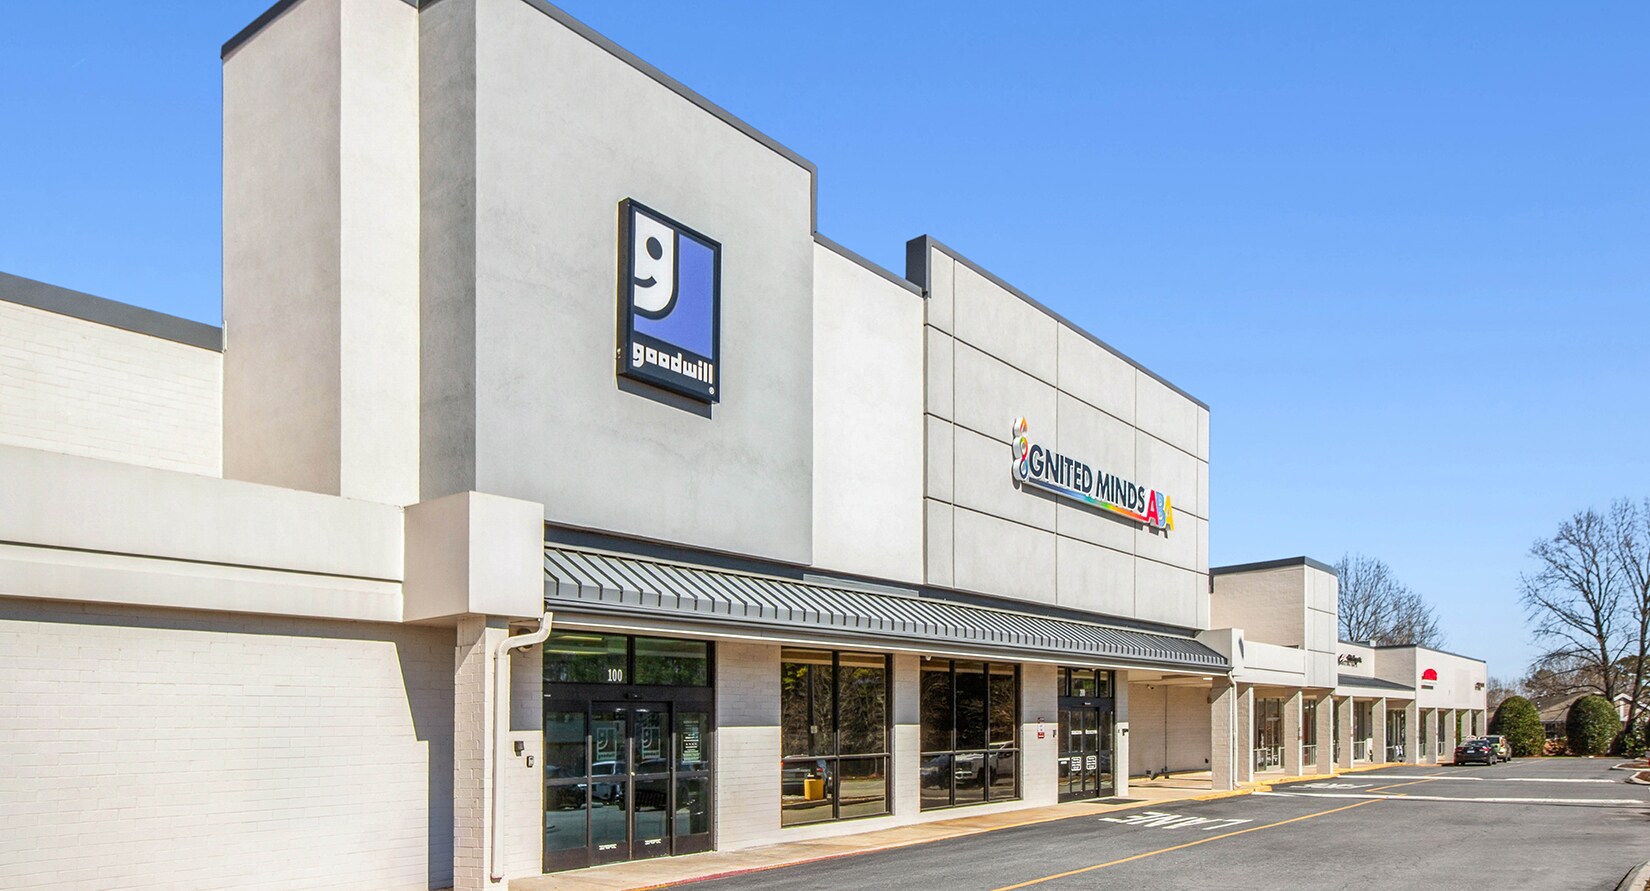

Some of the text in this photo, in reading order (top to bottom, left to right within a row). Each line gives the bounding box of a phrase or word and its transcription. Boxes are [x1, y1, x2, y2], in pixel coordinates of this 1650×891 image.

[632, 341, 714, 385] goodwill
[1095, 470, 1146, 514] MINDS
[1146, 489, 1175, 531] ABA
[607, 668, 623, 682] 100
